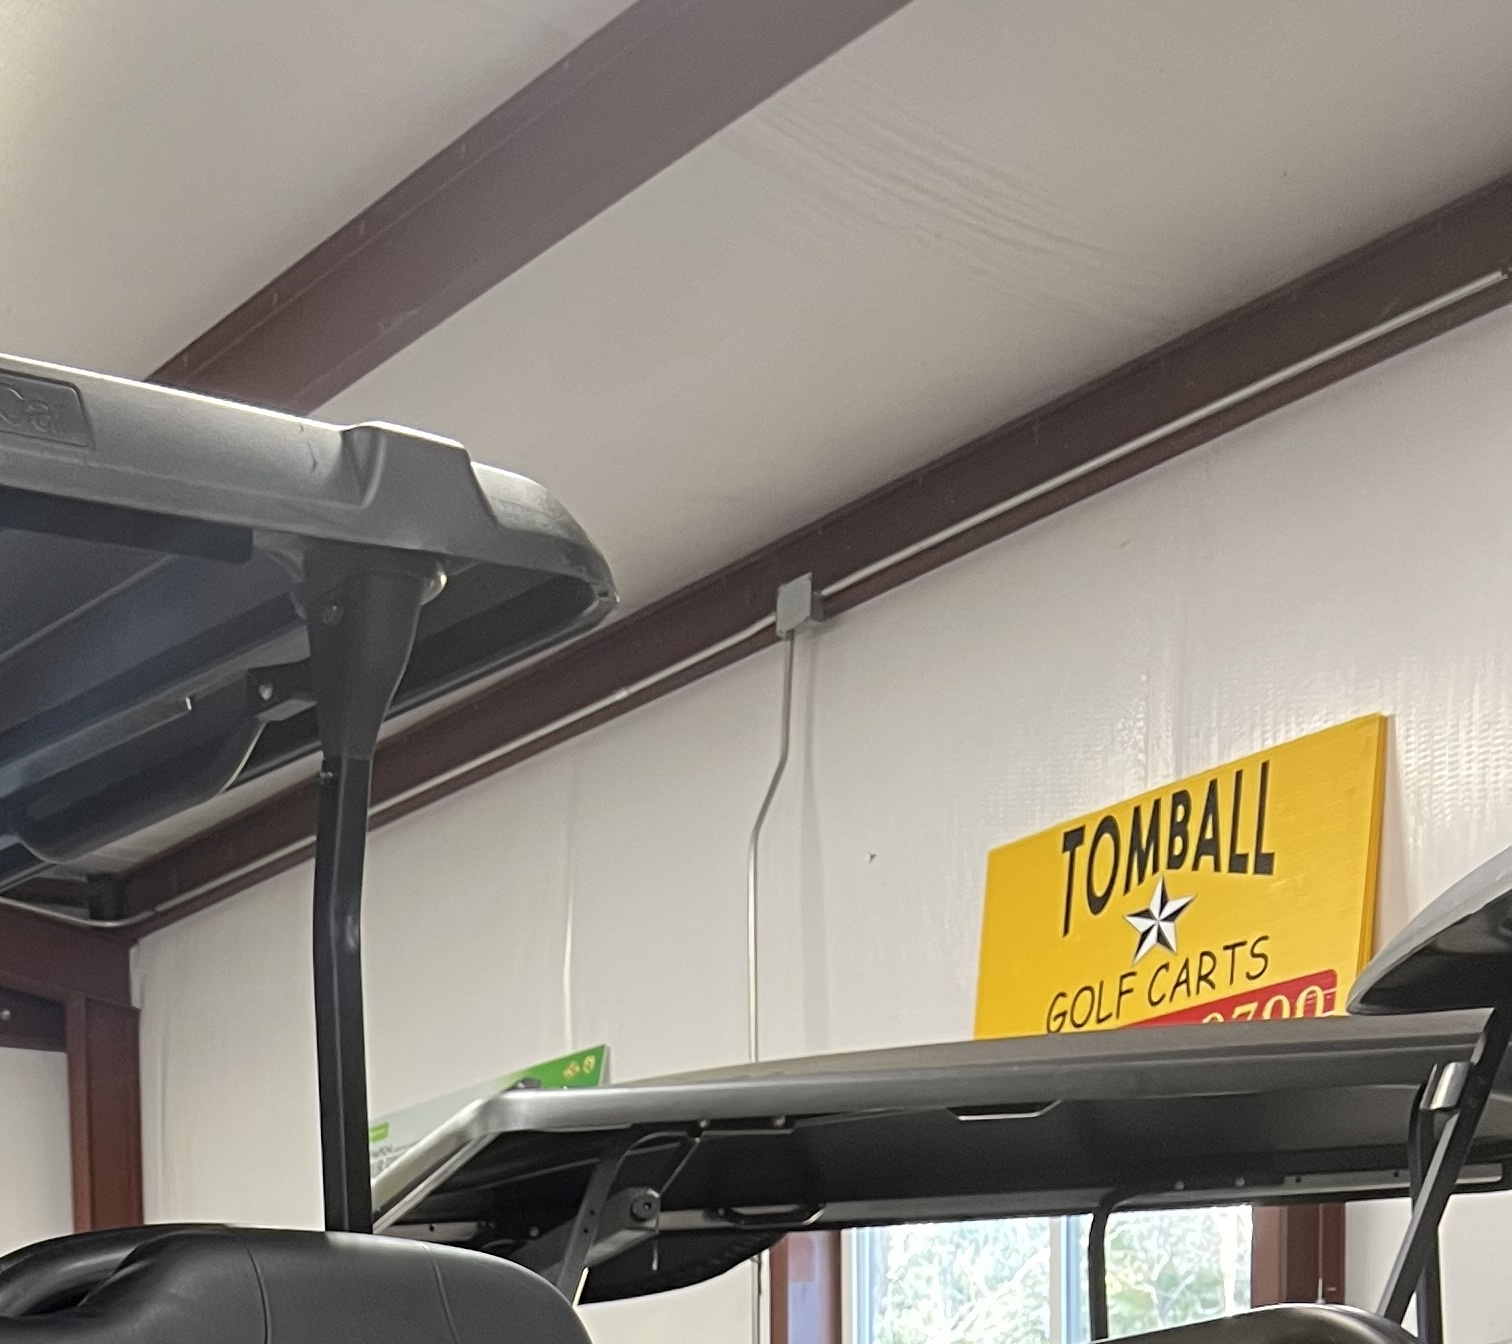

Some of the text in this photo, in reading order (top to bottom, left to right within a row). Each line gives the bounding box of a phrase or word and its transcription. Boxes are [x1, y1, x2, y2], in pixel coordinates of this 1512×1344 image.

[1061, 760, 1276, 939] TOMBALL
[1046, 935, 1270, 1034] GOLF CARTS
